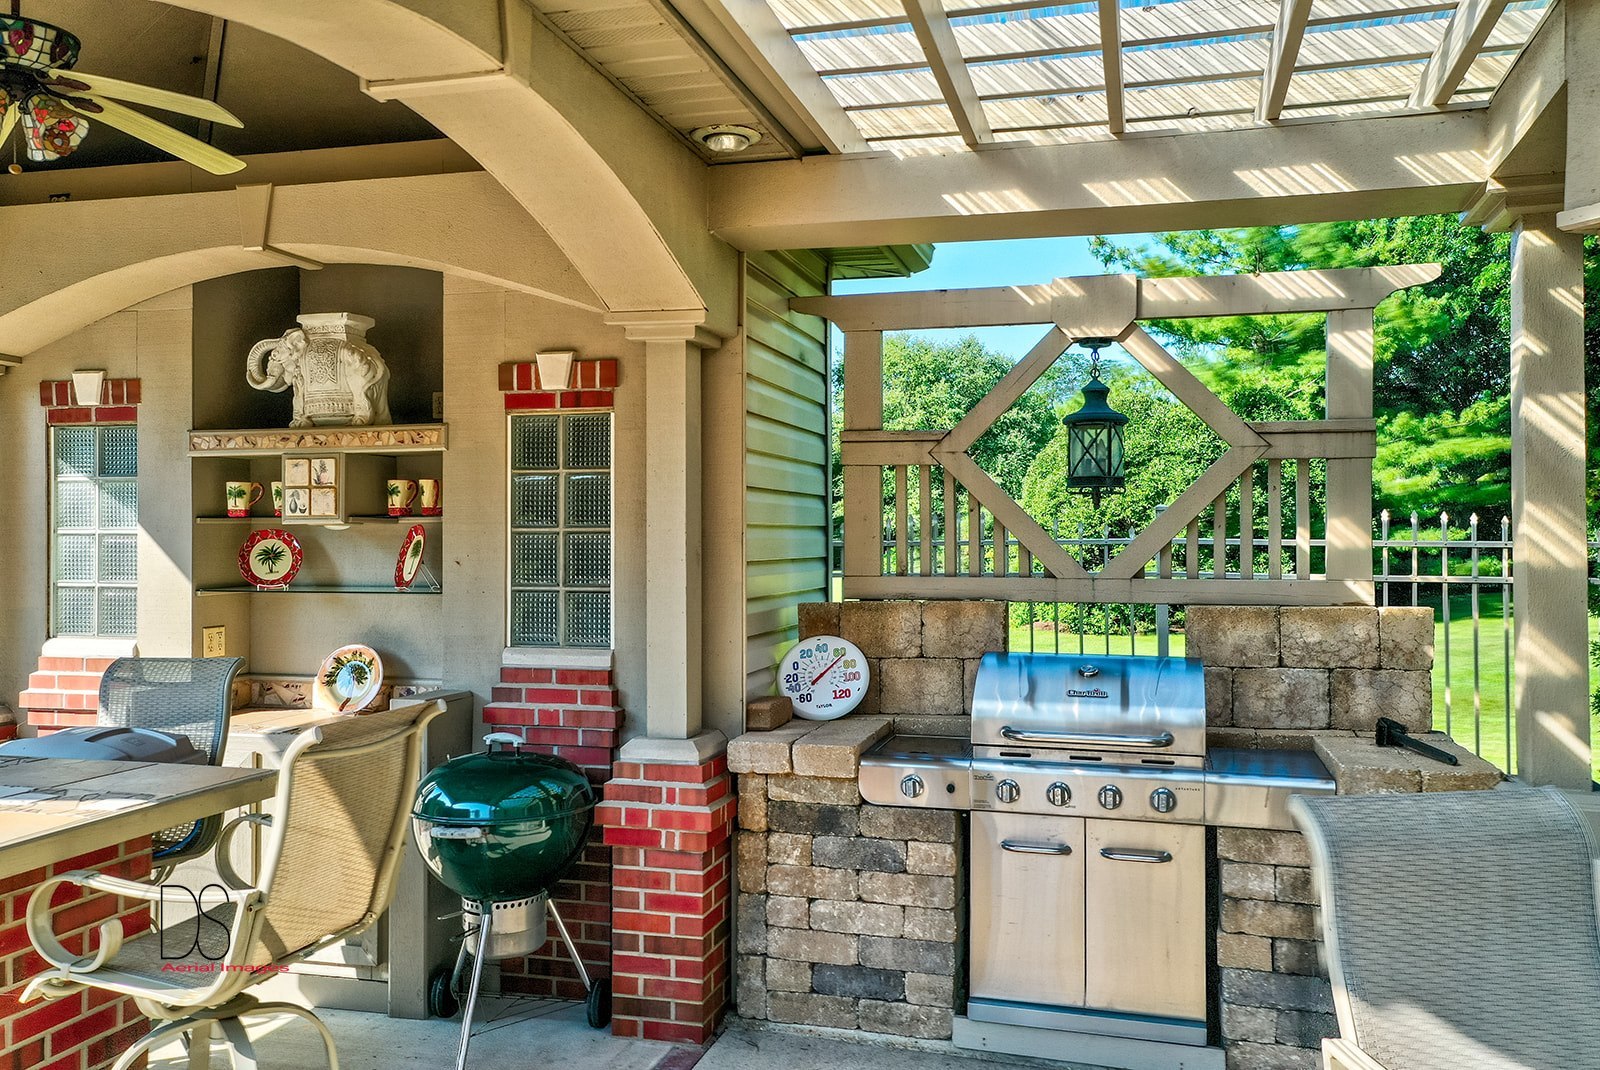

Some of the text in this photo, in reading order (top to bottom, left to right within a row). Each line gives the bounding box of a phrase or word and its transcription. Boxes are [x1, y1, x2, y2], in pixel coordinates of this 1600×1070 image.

[815, 643, 828, 653] 40
[833, 647, 846, 657] 60
[800, 649, 813, 659] 20
[792, 661, 799, 670] 0
[843, 659, 856, 669] 80
[784, 673, 799, 683] -20
[843, 671, 861, 682] 100
[796, 693, 812, 703] -60
[832, 688, 851, 699] 120
